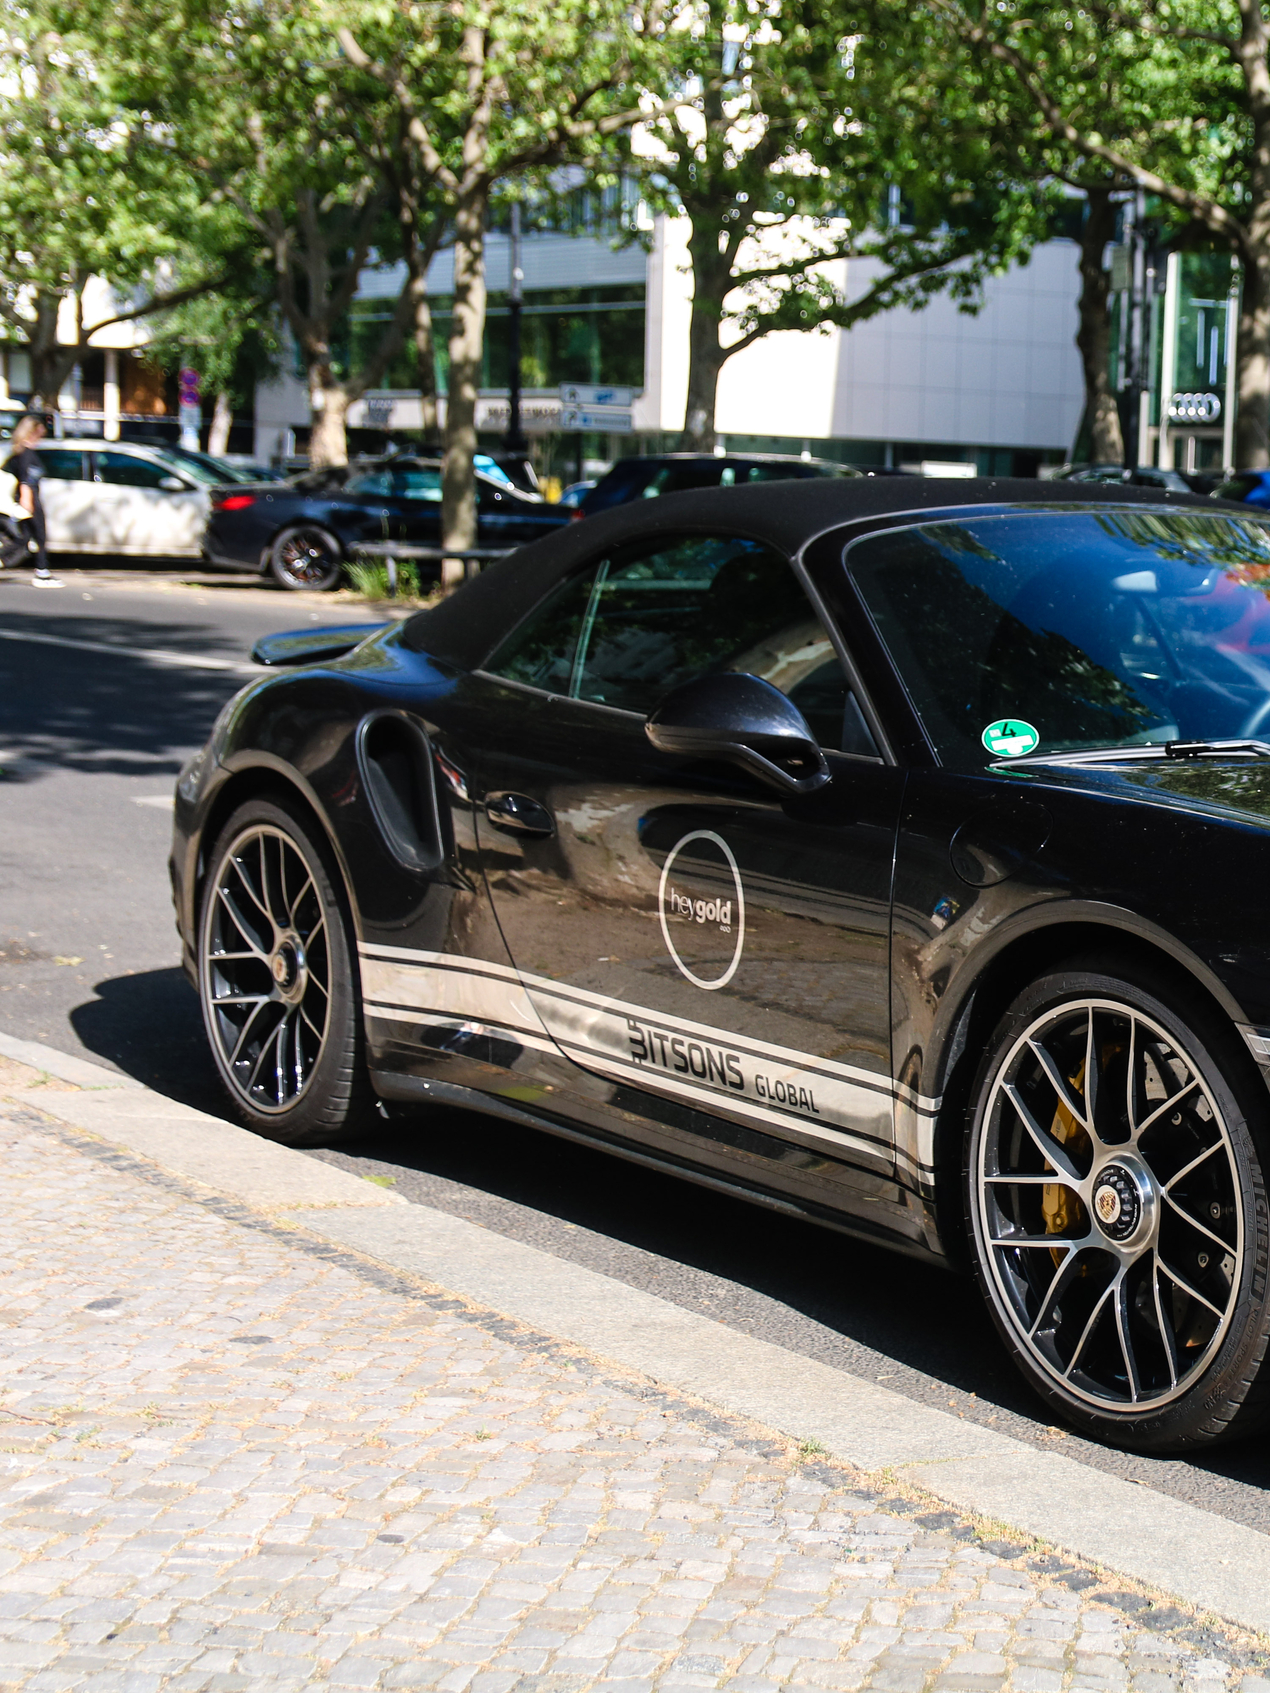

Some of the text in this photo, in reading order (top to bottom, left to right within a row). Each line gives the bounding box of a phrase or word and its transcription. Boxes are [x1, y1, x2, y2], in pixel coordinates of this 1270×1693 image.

[1001, 722, 1017, 738] 4
[755, 1073, 820, 1114] GLOBAL
[1250, 1163, 1268, 1296] MICHELIN
